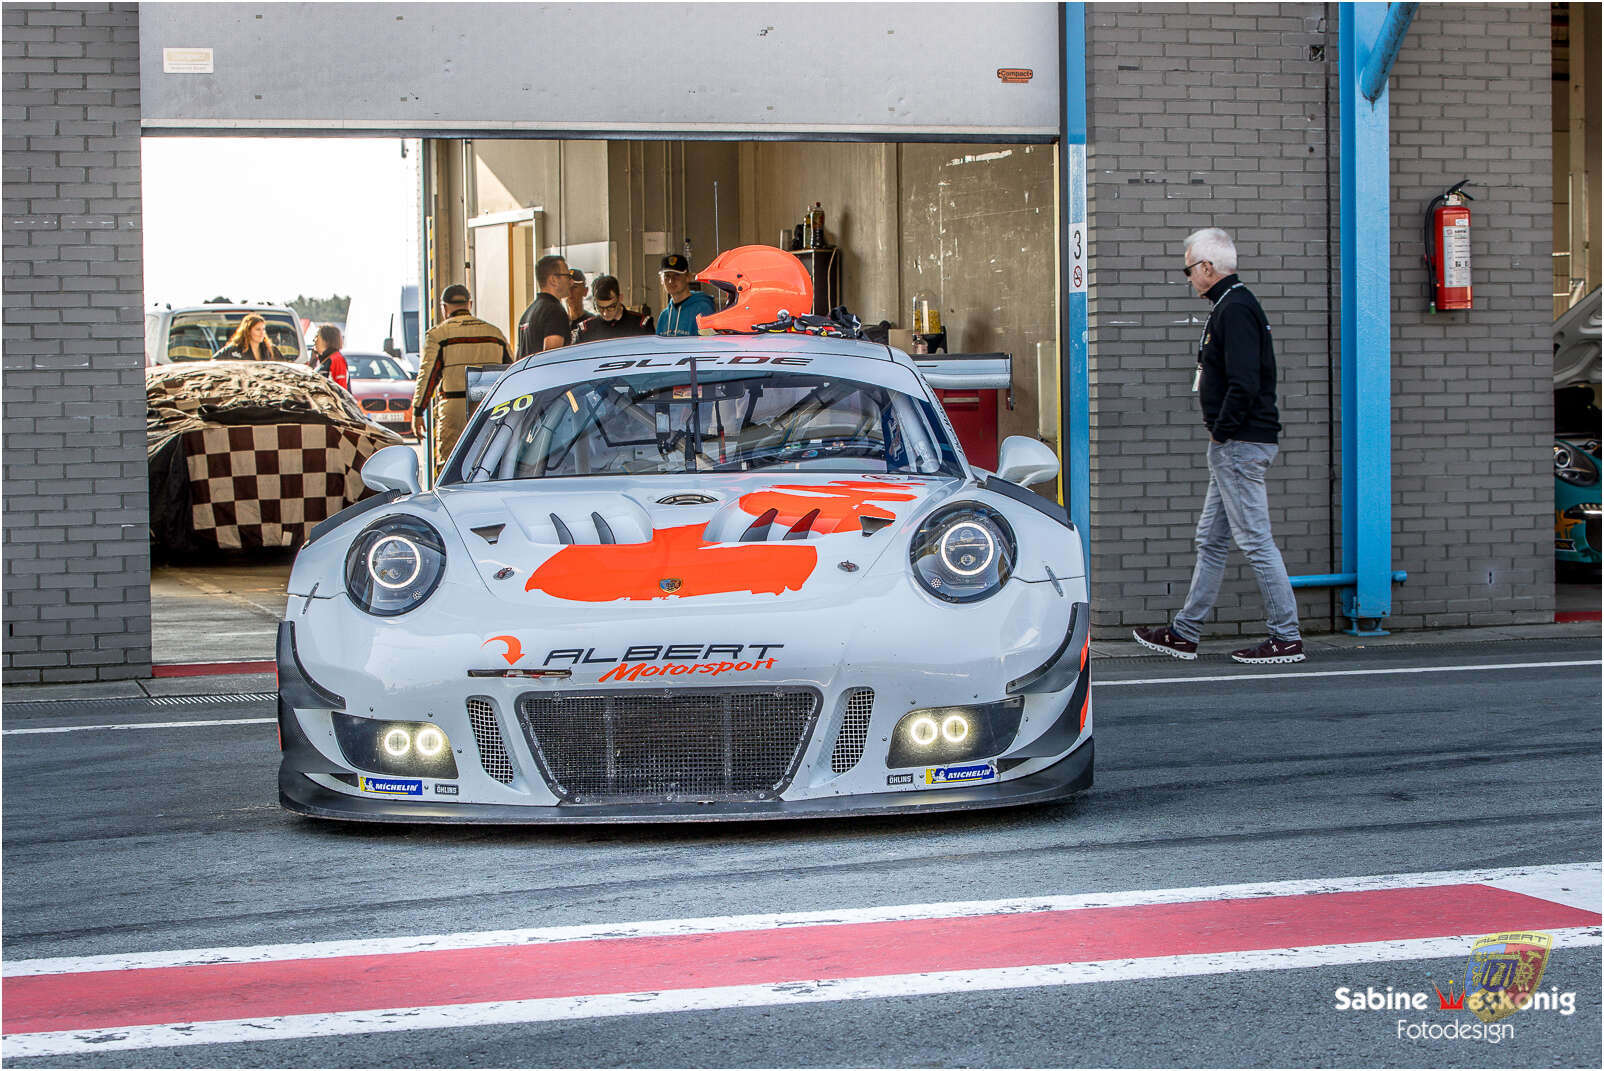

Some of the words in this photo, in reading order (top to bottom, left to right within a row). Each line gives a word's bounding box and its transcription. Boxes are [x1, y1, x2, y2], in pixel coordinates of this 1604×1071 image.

[1073, 230, 1082, 260] 3
[489, 394, 534, 421] 50
[543, 644, 785, 666] ALBERT
[598, 657, 779, 682] Motorsport
[947, 768, 992, 779] MICHELIN
[375, 783, 419, 792] MICHELIN
